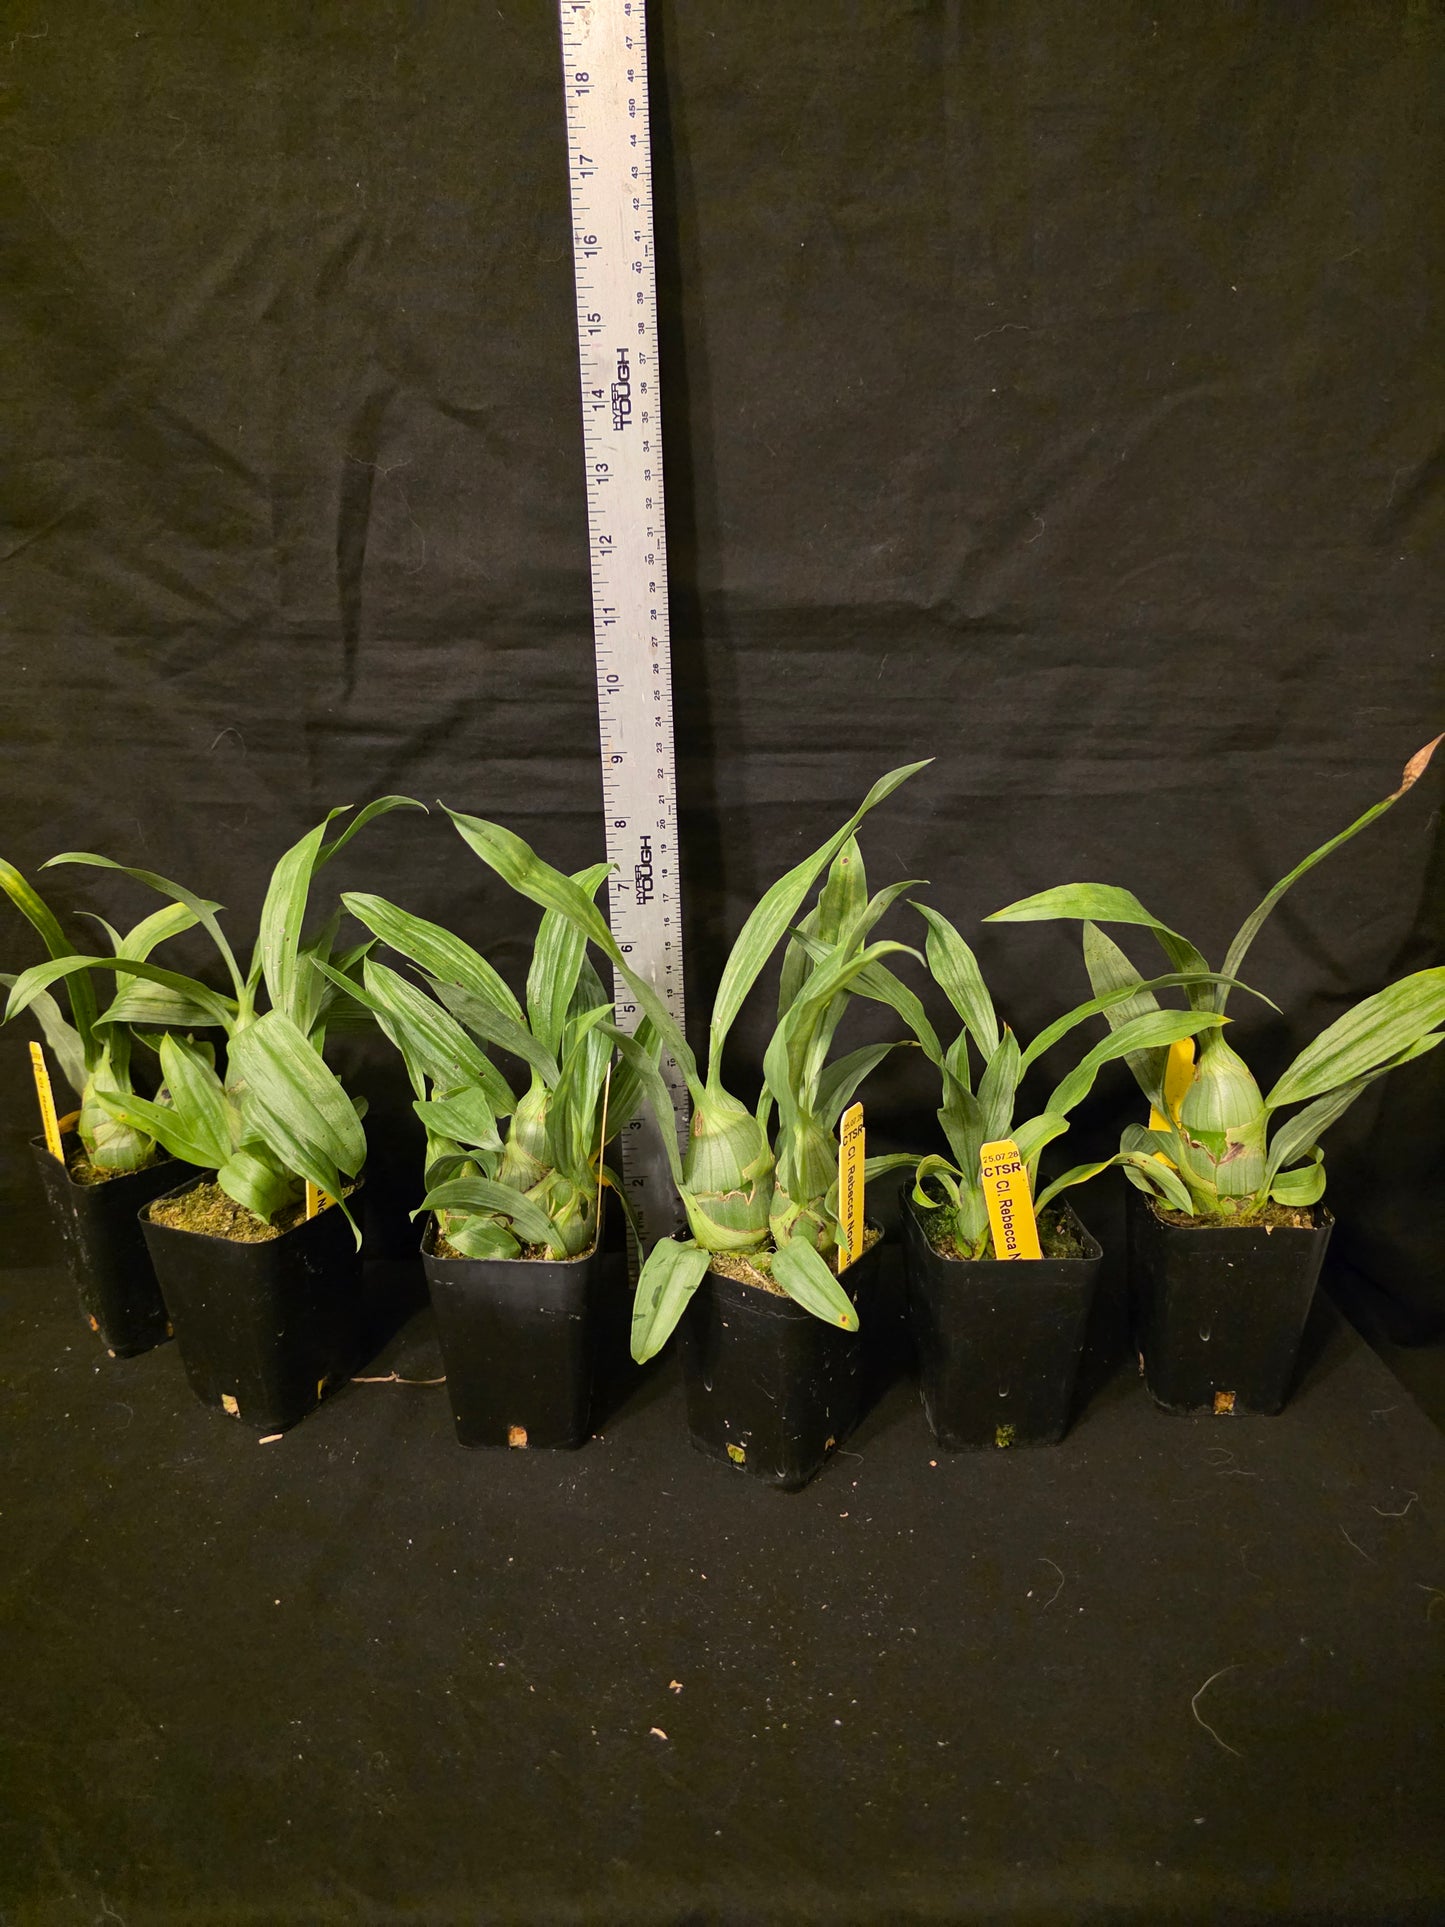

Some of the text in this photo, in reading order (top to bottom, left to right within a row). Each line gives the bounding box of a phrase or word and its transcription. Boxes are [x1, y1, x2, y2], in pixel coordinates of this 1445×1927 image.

[625, 3, 631, 16] 48
[626, 36, 632, 49] 47
[628, 69, 634, 82] 46
[575, 72, 589, 96] 18
[631, 135, 636, 147] 44
[579, 155, 593, 178] 17
[632, 166, 638, 179] 43
[633, 198, 639, 210] 42
[635, 230, 641, 241] 41
[584, 235, 597, 258] 16
[636, 261, 642, 273] 40
[637, 292, 643, 304] 39
[588, 313, 601, 335] 15
[638, 323, 645, 334] 38
[639, 353, 646, 364] 37
[617, 348, 632, 430] TOUGH
[641, 382, 647, 394] 36
[592, 389, 605, 411] 14
[611, 383, 620, 430] HYPER
[642, 411, 648, 423] 35
[643, 441, 649, 452] 34
[596, 463, 609, 484] 13
[645, 469, 651, 481] 33
[646, 498, 652, 509] 32
[647, 527, 653, 537] 31
[599, 535, 612, 556] 12
[648, 554, 654, 565] 30
[649, 582, 655, 592] 29
[603, 608, 616, 626] 11
[651, 609, 656, 620] 28
[652, 637, 658, 647] 27
[653, 664, 659, 674] 26
[607, 675, 619, 695] 10
[654, 690, 660, 700] 25
[655, 717, 661, 727] 24
[657, 743, 662, 753] 23
[611, 755, 623, 763] 9
[658, 768, 663, 779] 22
[659, 795, 665, 804] 21
[660, 819, 666, 829] 20
[661, 844, 667, 853] 19
[640, 836, 654, 904] TOUGH
[662, 869, 668, 878] 18
[635, 865, 643, 905] HYPER
[663, 894, 669, 903] 17
[664, 918, 670, 927] 16
[665, 942, 671, 951] 15
[666, 965, 672, 974] 14
[667, 989, 673, 998] 13
[630, 1122, 642, 1130] 3
[843, 1124, 863, 1146] CTSR
[984, 1162, 1021, 1177] CTSR
[632, 1179, 644, 1187] 2
[999, 1199, 1016, 1250] Rebecca
